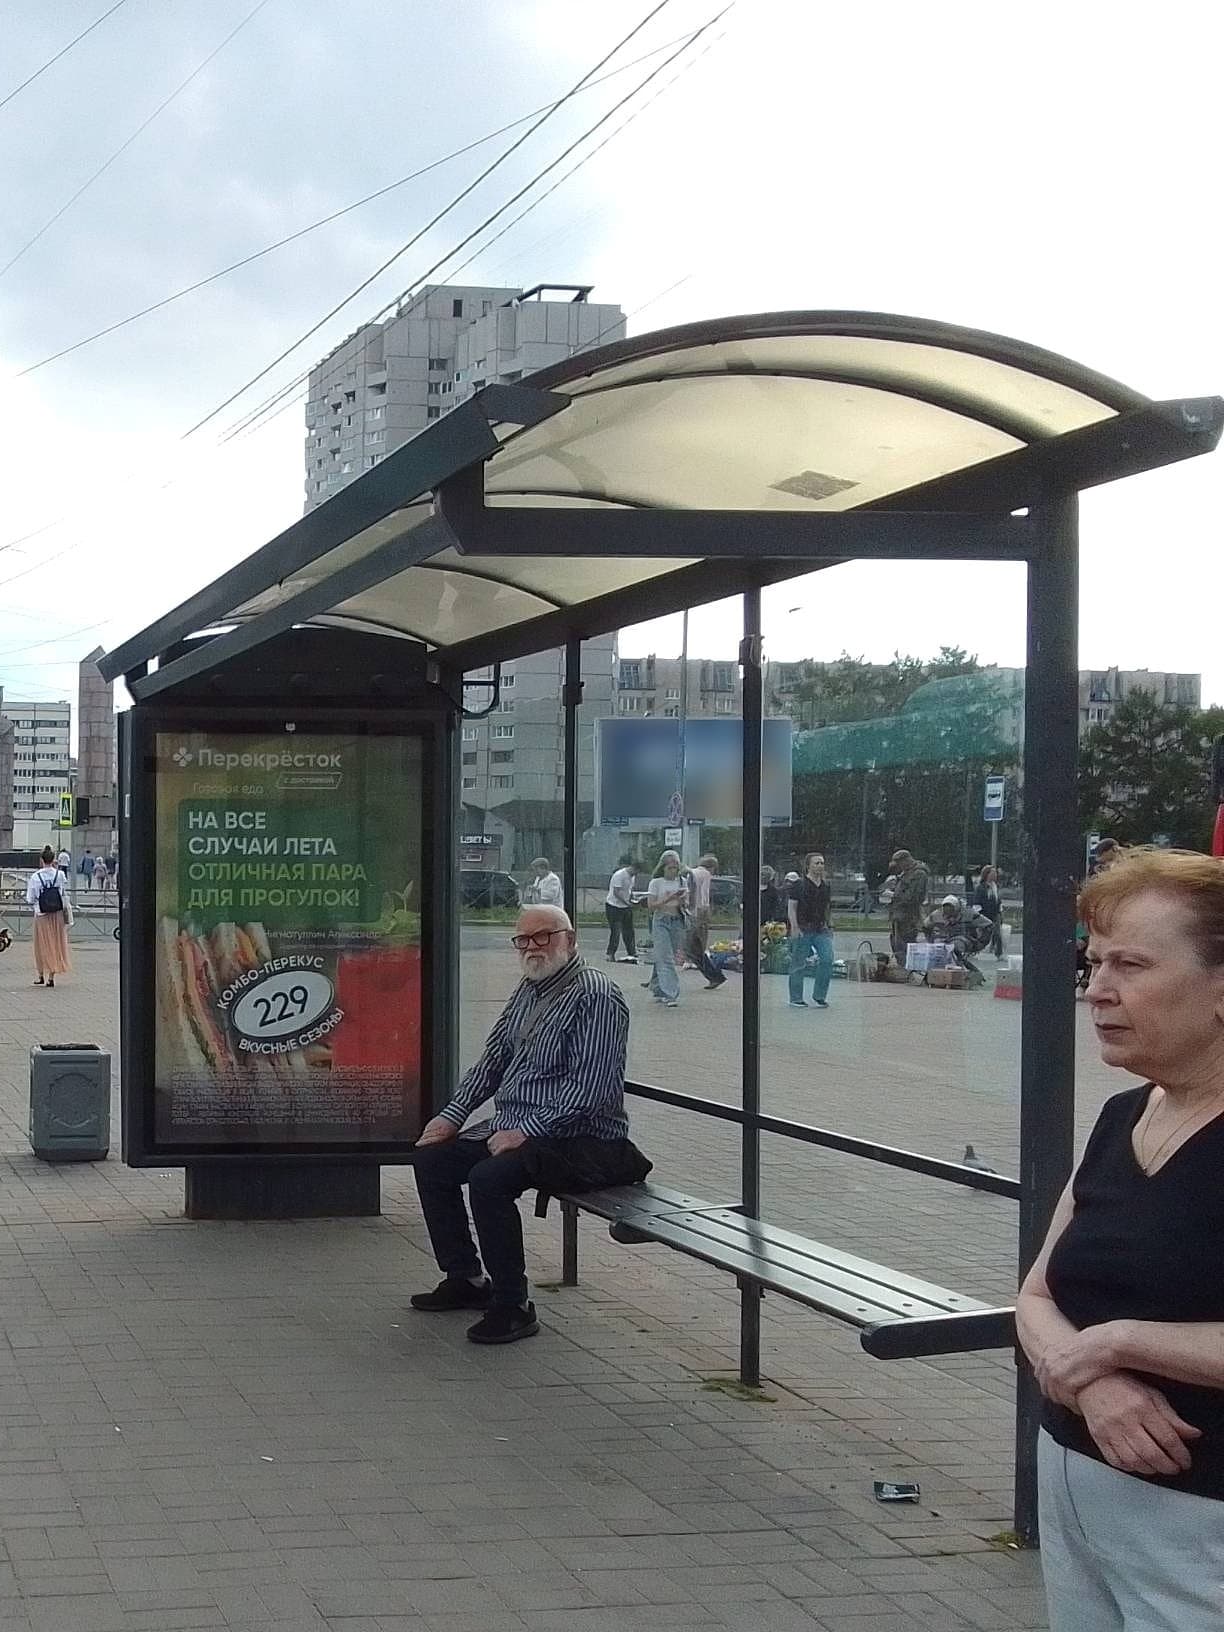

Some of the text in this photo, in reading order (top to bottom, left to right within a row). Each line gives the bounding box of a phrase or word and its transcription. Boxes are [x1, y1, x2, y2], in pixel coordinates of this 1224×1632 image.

[198, 749, 342, 771] Перекрёсток
[188, 811, 266, 829] НА ВСЕ
[188, 837, 337, 855] СЛУЧАИ ЛЕТА
[188, 863, 367, 881] ОТЛИЧНАЯ ПАРА
[188, 888, 360, 908] ДЛЯ ПРОГУЛОК!
[217, 955, 325, 1009] КОМБО-ПЕРЕКУС
[253, 985, 309, 1028] 229
[238, 1007, 345, 1054] ВКУСНЫЕ СЕЗОНЫ
